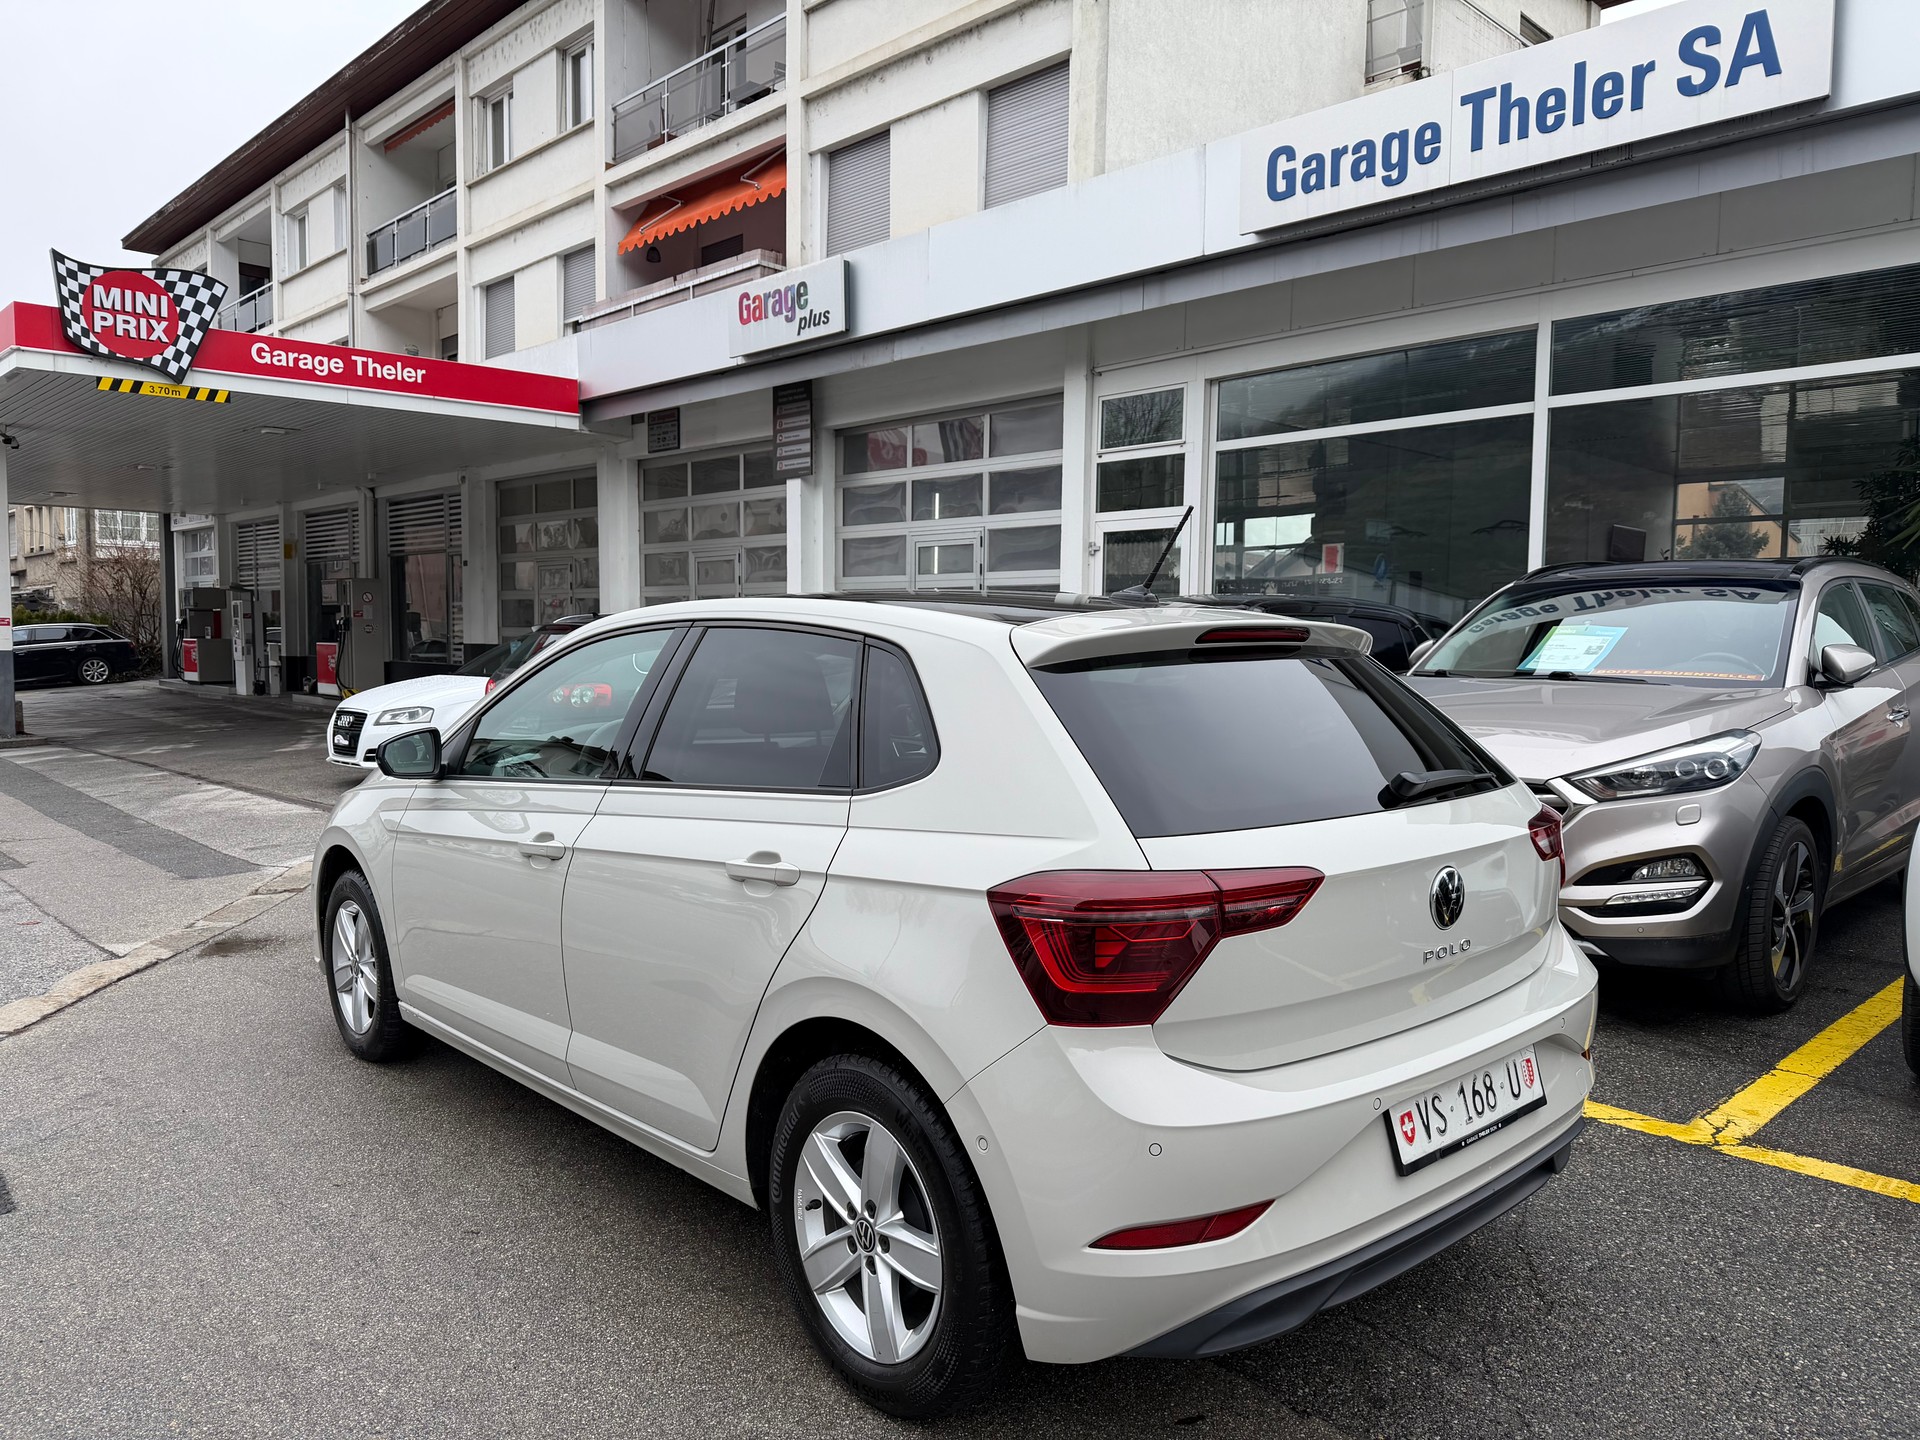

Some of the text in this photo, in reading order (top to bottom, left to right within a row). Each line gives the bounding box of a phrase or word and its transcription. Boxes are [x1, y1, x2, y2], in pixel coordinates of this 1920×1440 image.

[1266, 9, 1783, 203] Garage Theler SA
[93, 284, 169, 319] MINI
[738, 281, 809, 326] Garage
[797, 309, 831, 336] plus
[93, 311, 170, 343] PRIX
[251, 342, 427, 384] Garage Theler
[1423, 939, 1471, 964] POLO
[1457, 1069, 1498, 1125] 168
[771, 1104, 801, 1204] Continental
